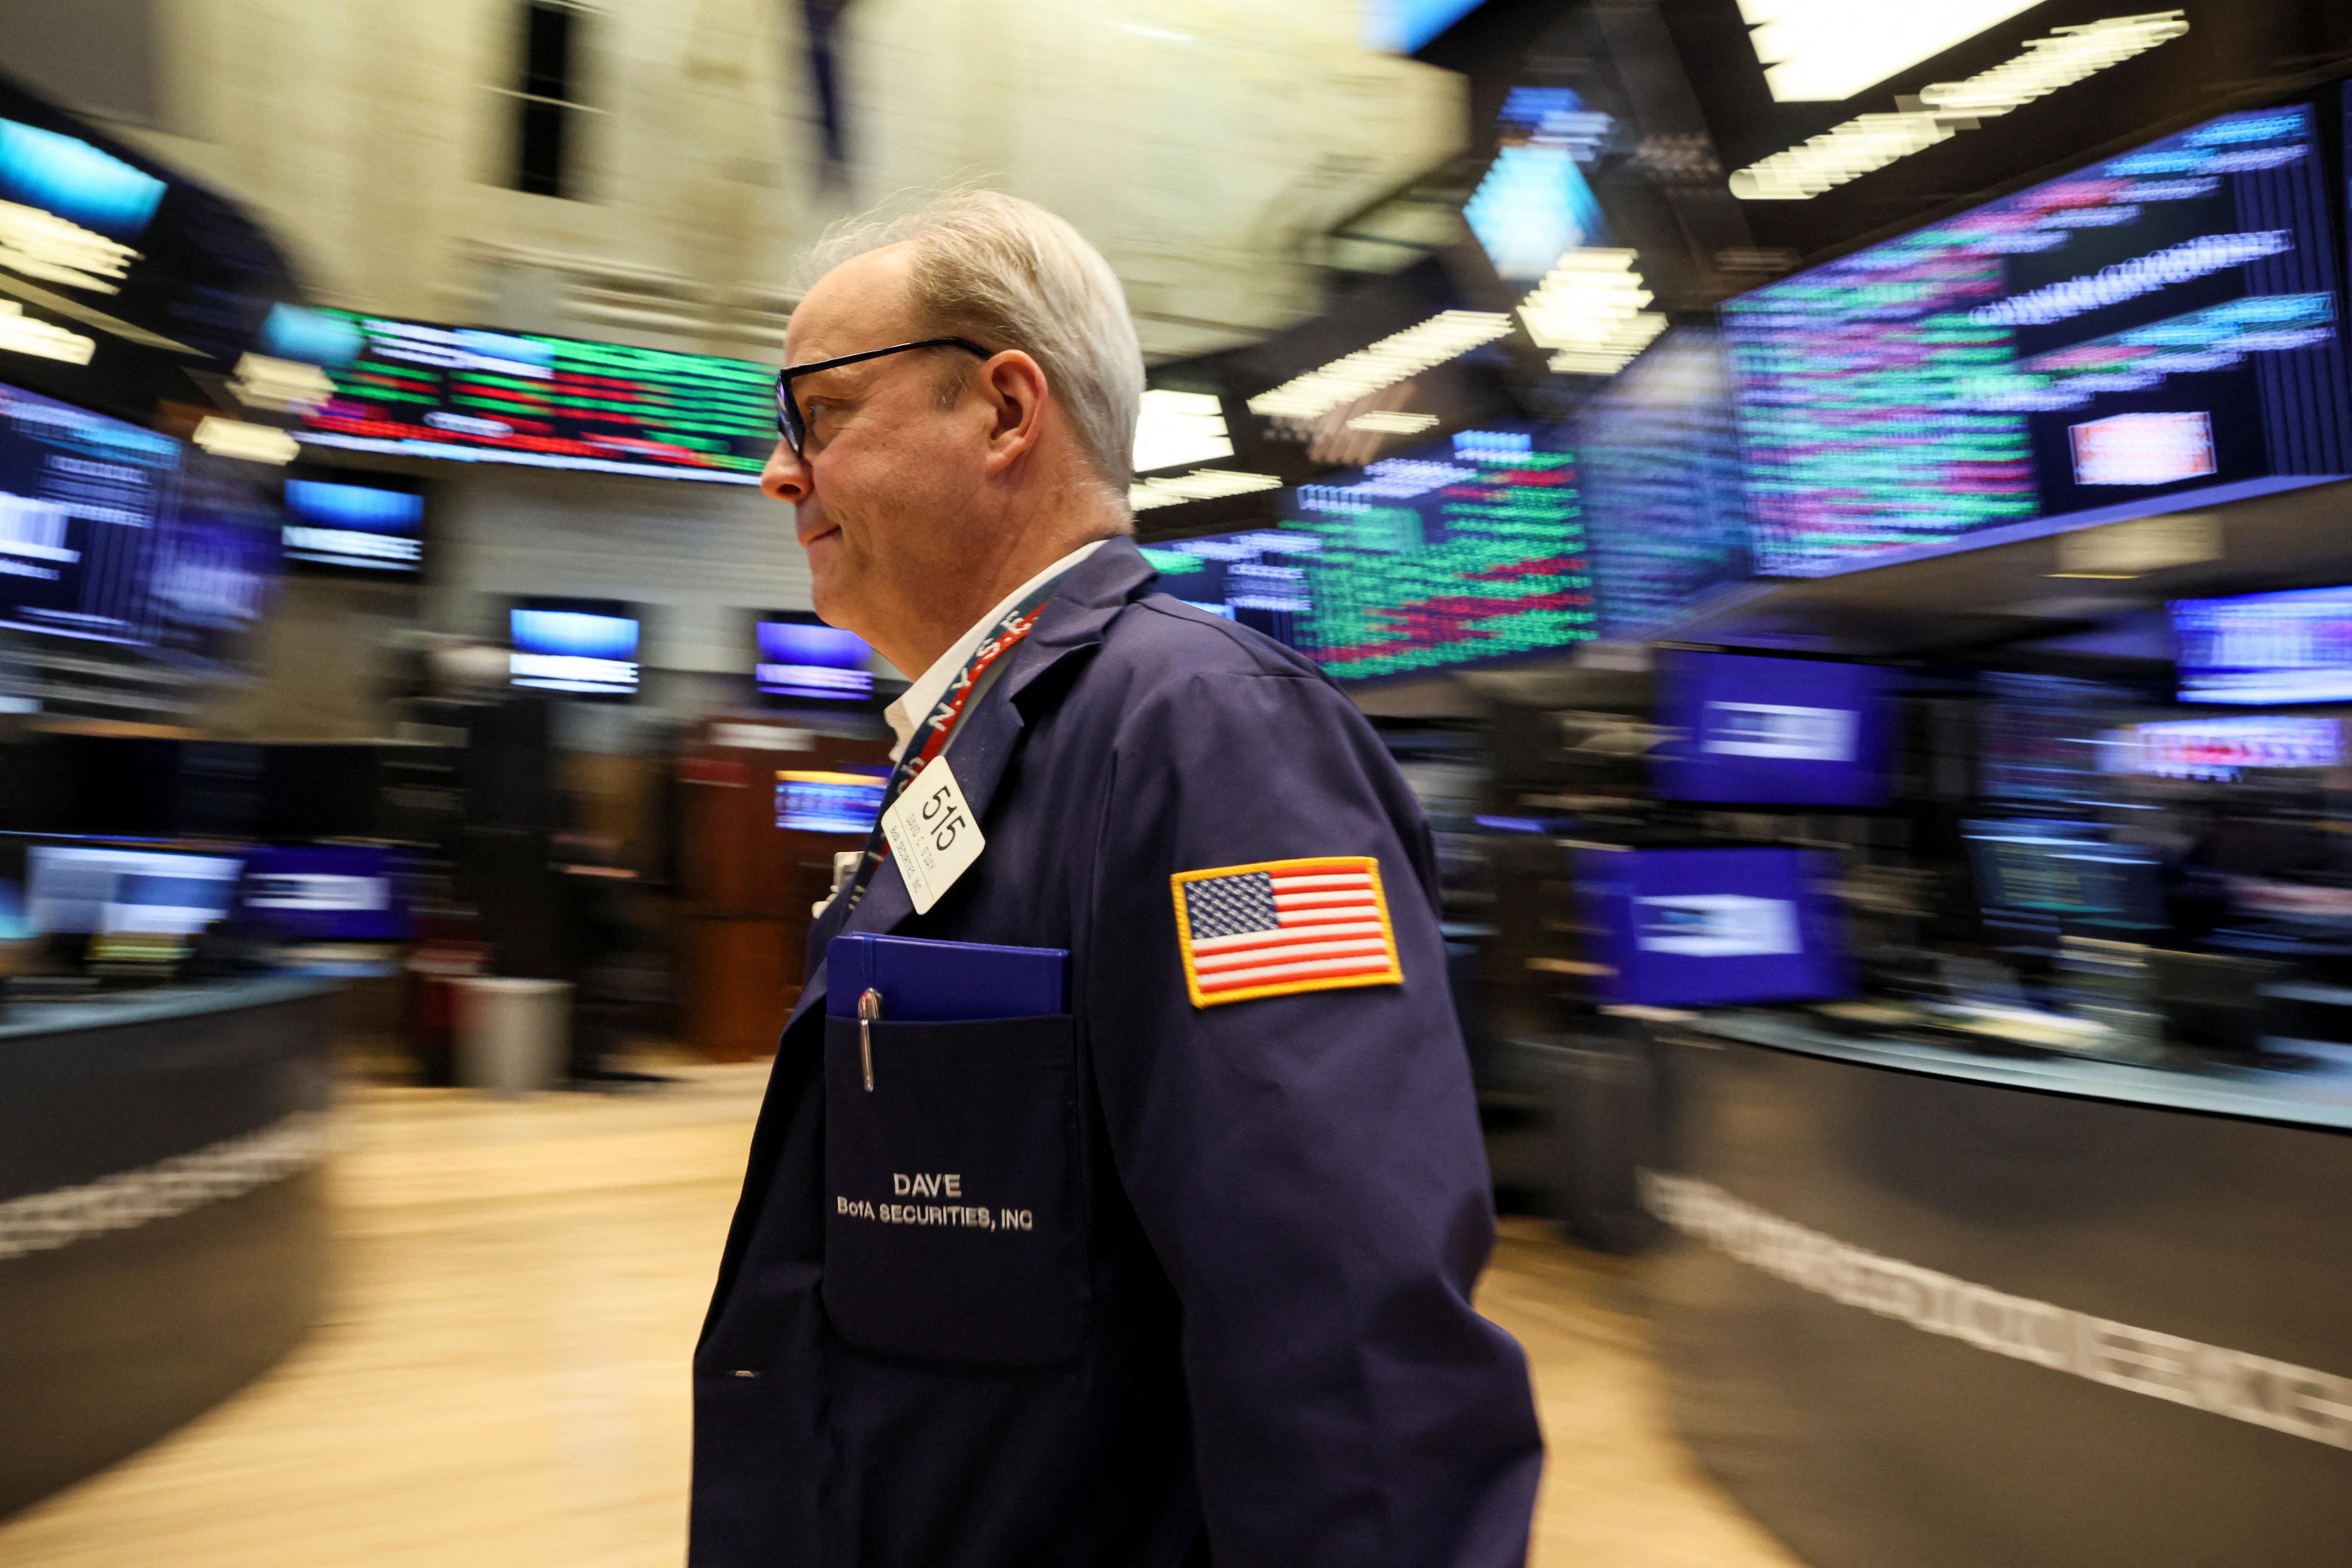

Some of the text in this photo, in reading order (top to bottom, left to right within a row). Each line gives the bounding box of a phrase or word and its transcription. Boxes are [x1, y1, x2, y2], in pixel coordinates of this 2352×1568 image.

[923, 785, 966, 851] 515
[893, 1173, 962, 1198] DAVE
[837, 1196, 1033, 1232] BofA SECURITIES, INC
